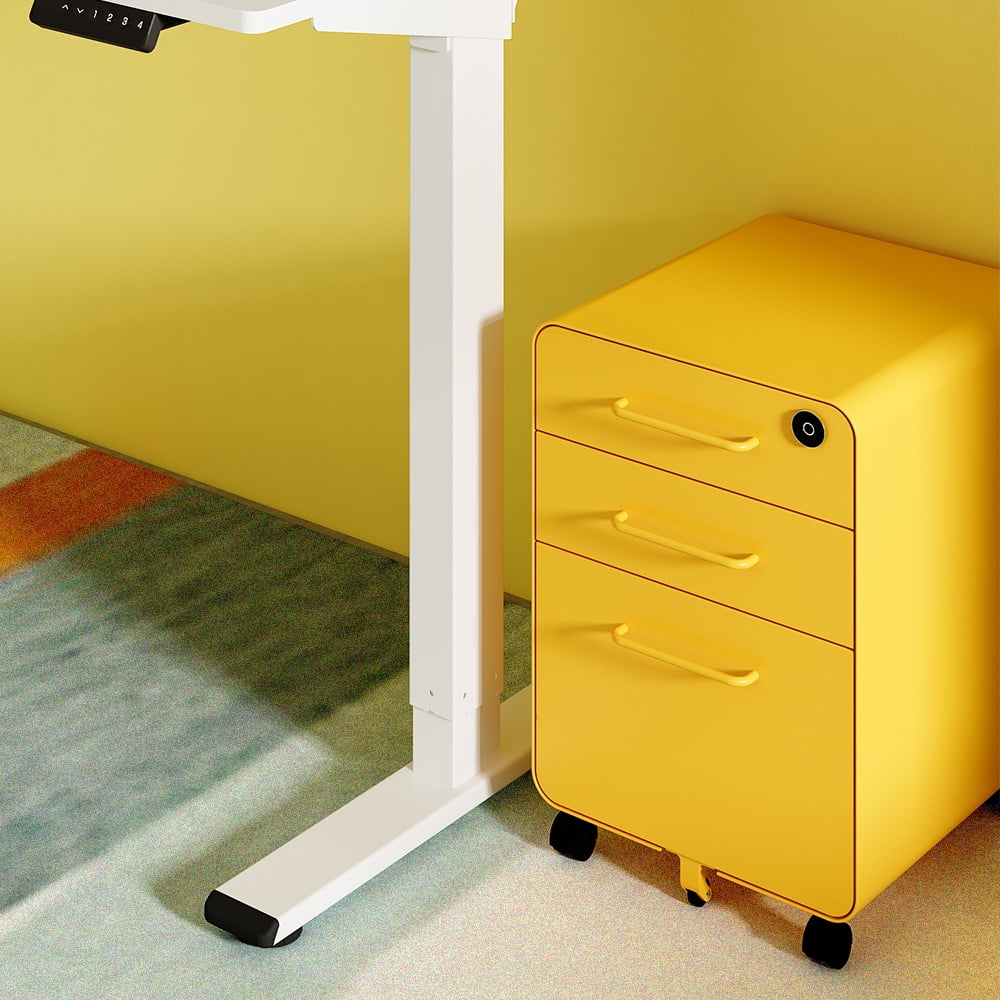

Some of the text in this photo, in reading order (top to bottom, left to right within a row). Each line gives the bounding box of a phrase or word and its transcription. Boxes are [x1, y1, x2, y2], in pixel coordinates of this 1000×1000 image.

[94, 10, 143, 29] 1 2 3 4
